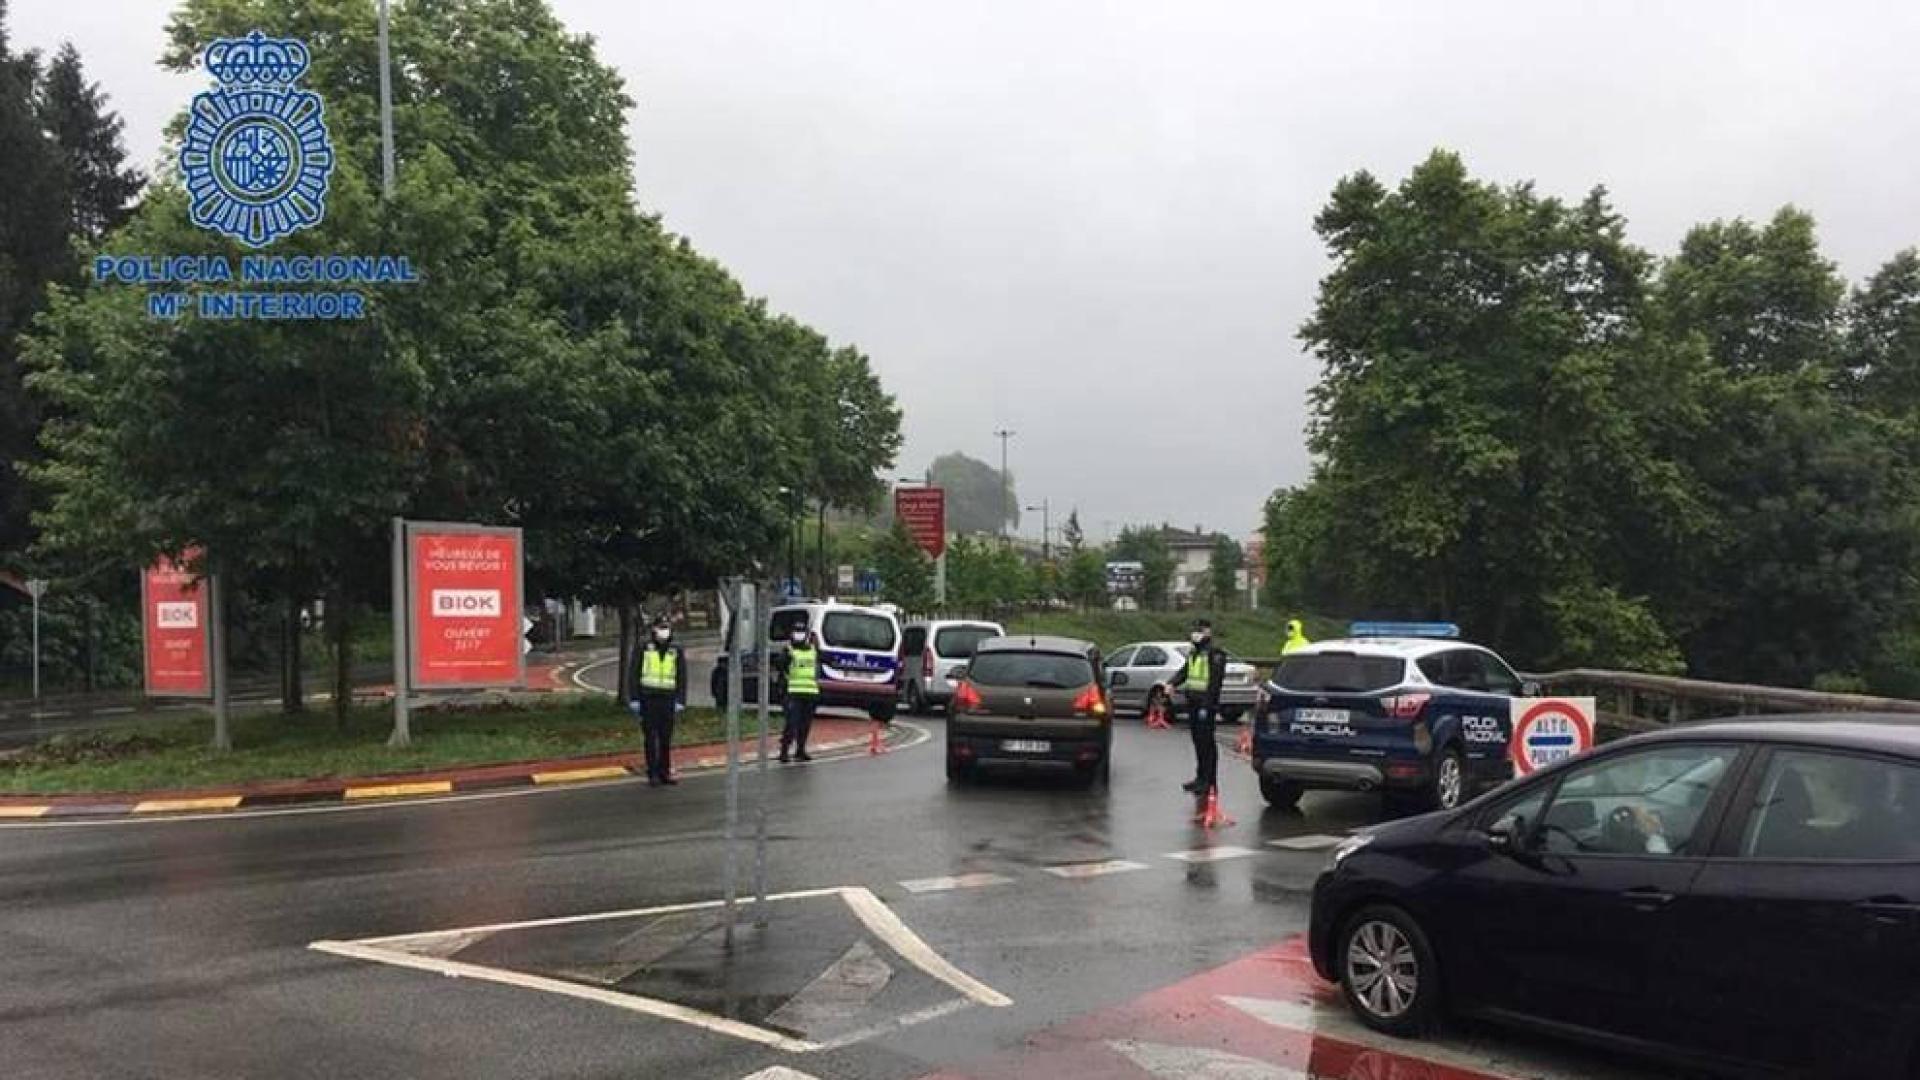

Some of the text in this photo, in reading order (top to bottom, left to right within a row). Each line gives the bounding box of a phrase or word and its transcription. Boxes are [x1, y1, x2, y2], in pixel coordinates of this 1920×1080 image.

[424, 560, 456, 571] VOUS
[438, 596, 494, 610] BIOK
[444, 627, 491, 639] OUVERT
[1536, 718, 1568, 732] ALTO
